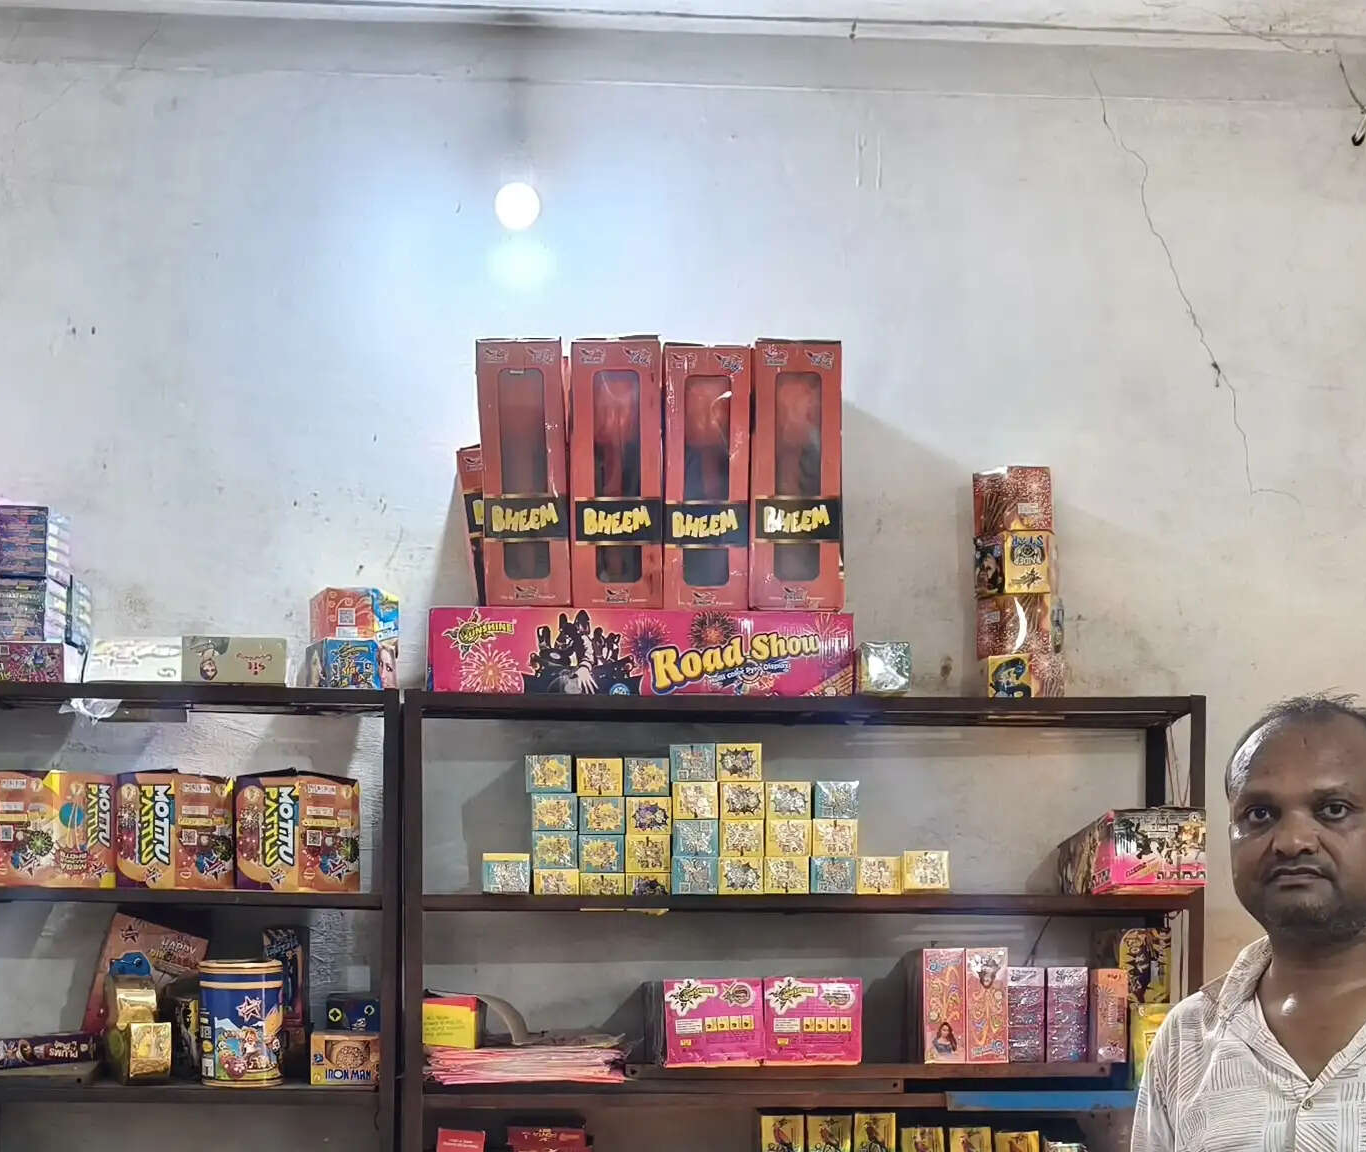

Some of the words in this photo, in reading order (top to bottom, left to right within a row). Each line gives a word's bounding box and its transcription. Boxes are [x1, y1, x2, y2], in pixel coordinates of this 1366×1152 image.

[491, 503, 560, 532] BHEEM
[583, 504, 651, 536] BHEEM
[672, 509, 738, 539] BHEEM
[763, 504, 830, 533] BHEEM
[651, 638, 747, 691] Road
[748, 632, 821, 662] Show
[98, 784, 112, 848] MOTTU
[153, 785, 170, 866] MOTTU
[278, 786, 295, 866] MOTTU
[325, 1067, 349, 1081] IRON
[350, 1068, 372, 1081] MAN
